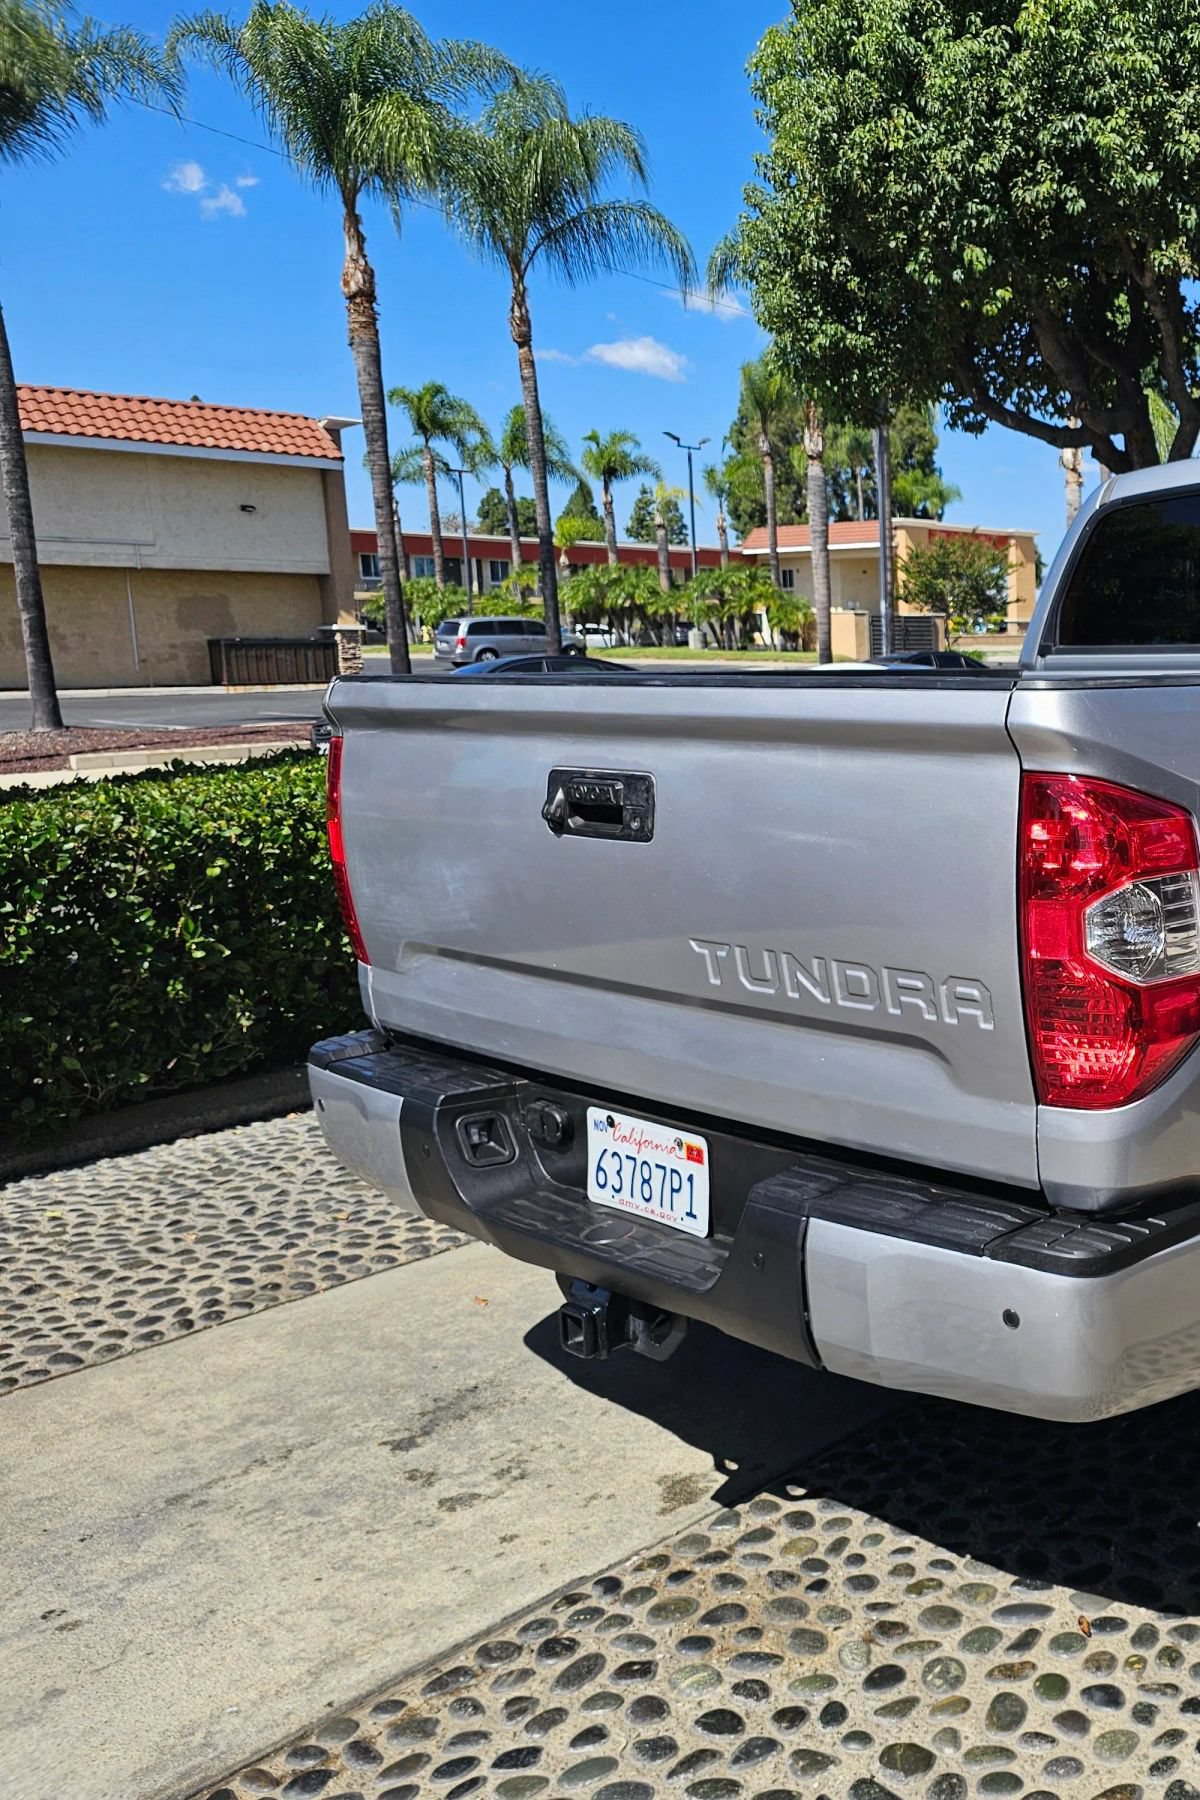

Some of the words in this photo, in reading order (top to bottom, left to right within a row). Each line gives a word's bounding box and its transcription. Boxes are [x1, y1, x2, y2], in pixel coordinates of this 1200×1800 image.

[688, 937, 995, 1030] TUNDRA
[593, 1119, 609, 1133] NOV
[612, 1122, 685, 1159] California
[595, 1148, 697, 1220] 63787P1
